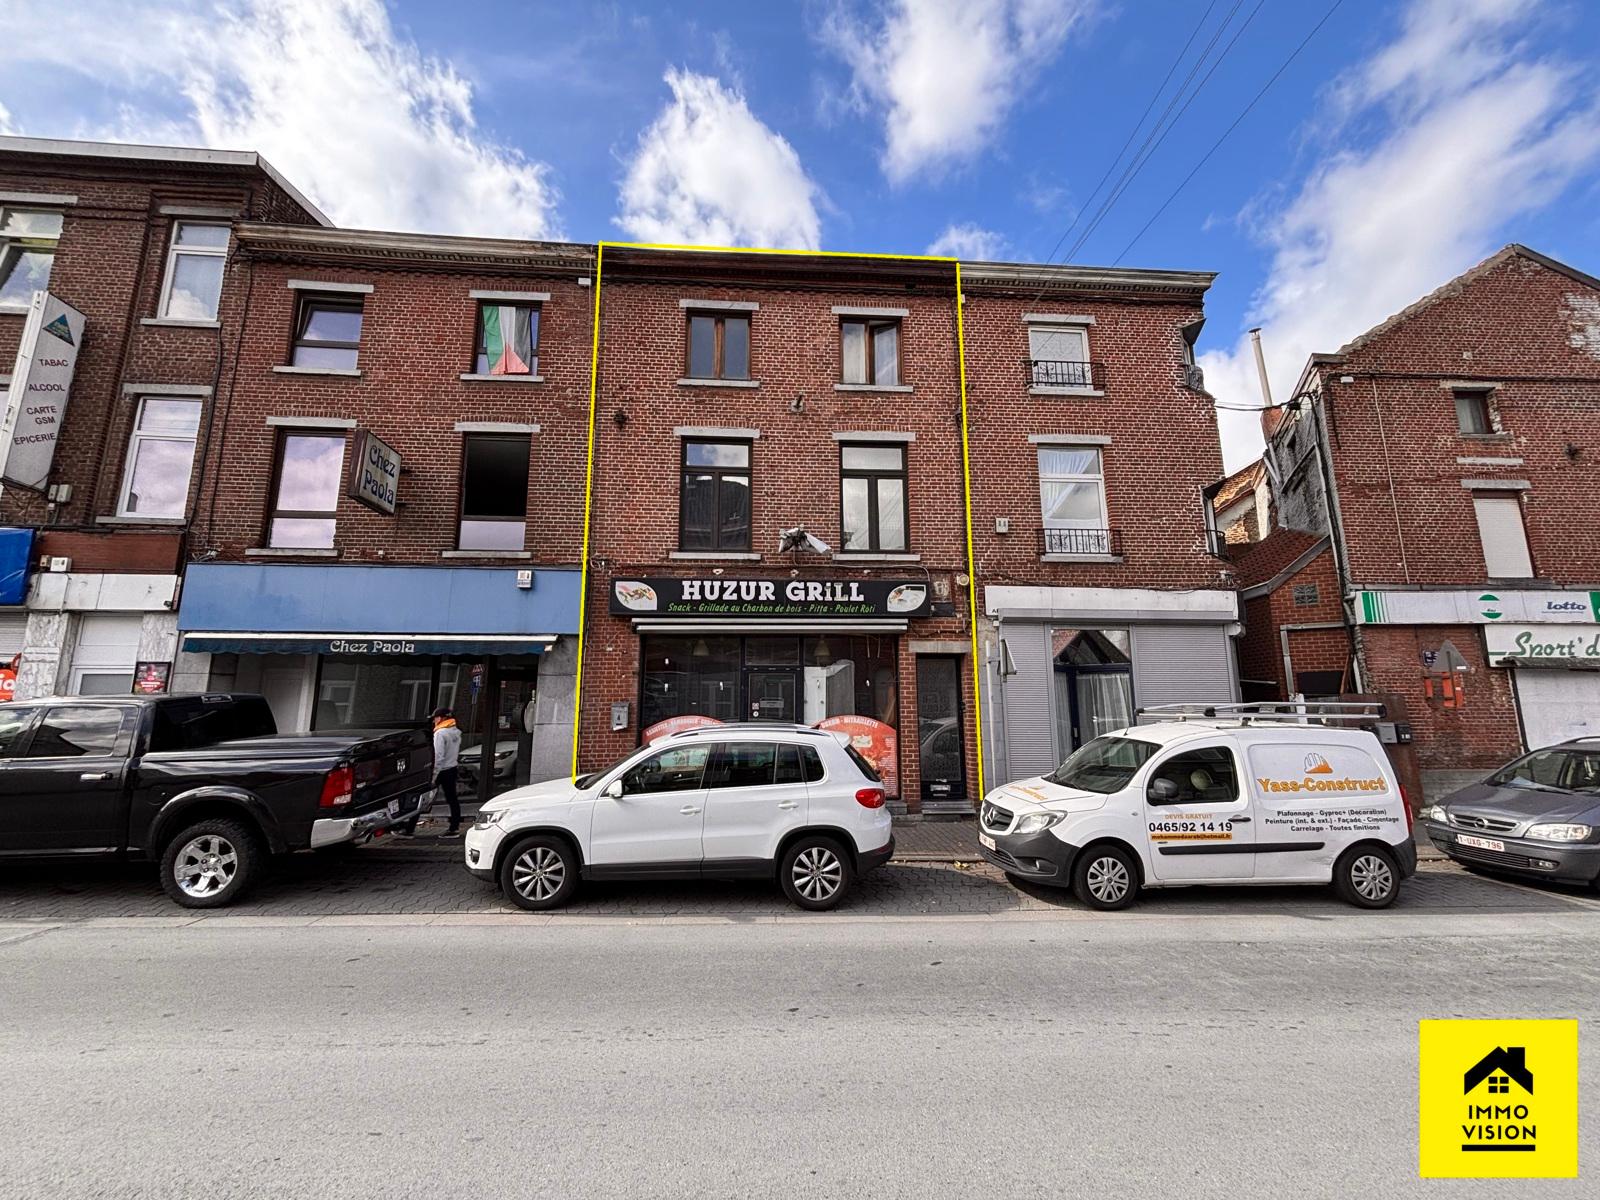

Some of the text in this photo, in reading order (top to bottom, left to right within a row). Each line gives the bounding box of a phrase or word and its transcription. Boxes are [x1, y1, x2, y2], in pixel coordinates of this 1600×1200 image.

[37, 358, 69, 367] TABAC
[28, 383, 66, 392] ALCOOL
[26, 405, 57, 415] CARTE
[35, 416, 56, 425] GSM
[13, 432, 57, 445] EPICERIE
[369, 444, 396, 478] Chez
[363, 468, 394, 505] Paola
[681, 580, 776, 601] HUZUR
[667, 602, 691, 612] Snack
[698, 602, 728, 612] Grillade
[730, 604, 740, 612] au
[742, 603, 773, 612] Charbon
[775, 603, 785, 613] de
[786, 603, 801, 613] bois
[834, 603, 858, 613] Poulet
[330, 640, 415, 653] Chez Paola
[1257, 777, 1386, 793] Yass-Construct
[1148, 821, 1233, 833] 0465/92 14 19
[1290, 825, 1325, 833] Carrelage
